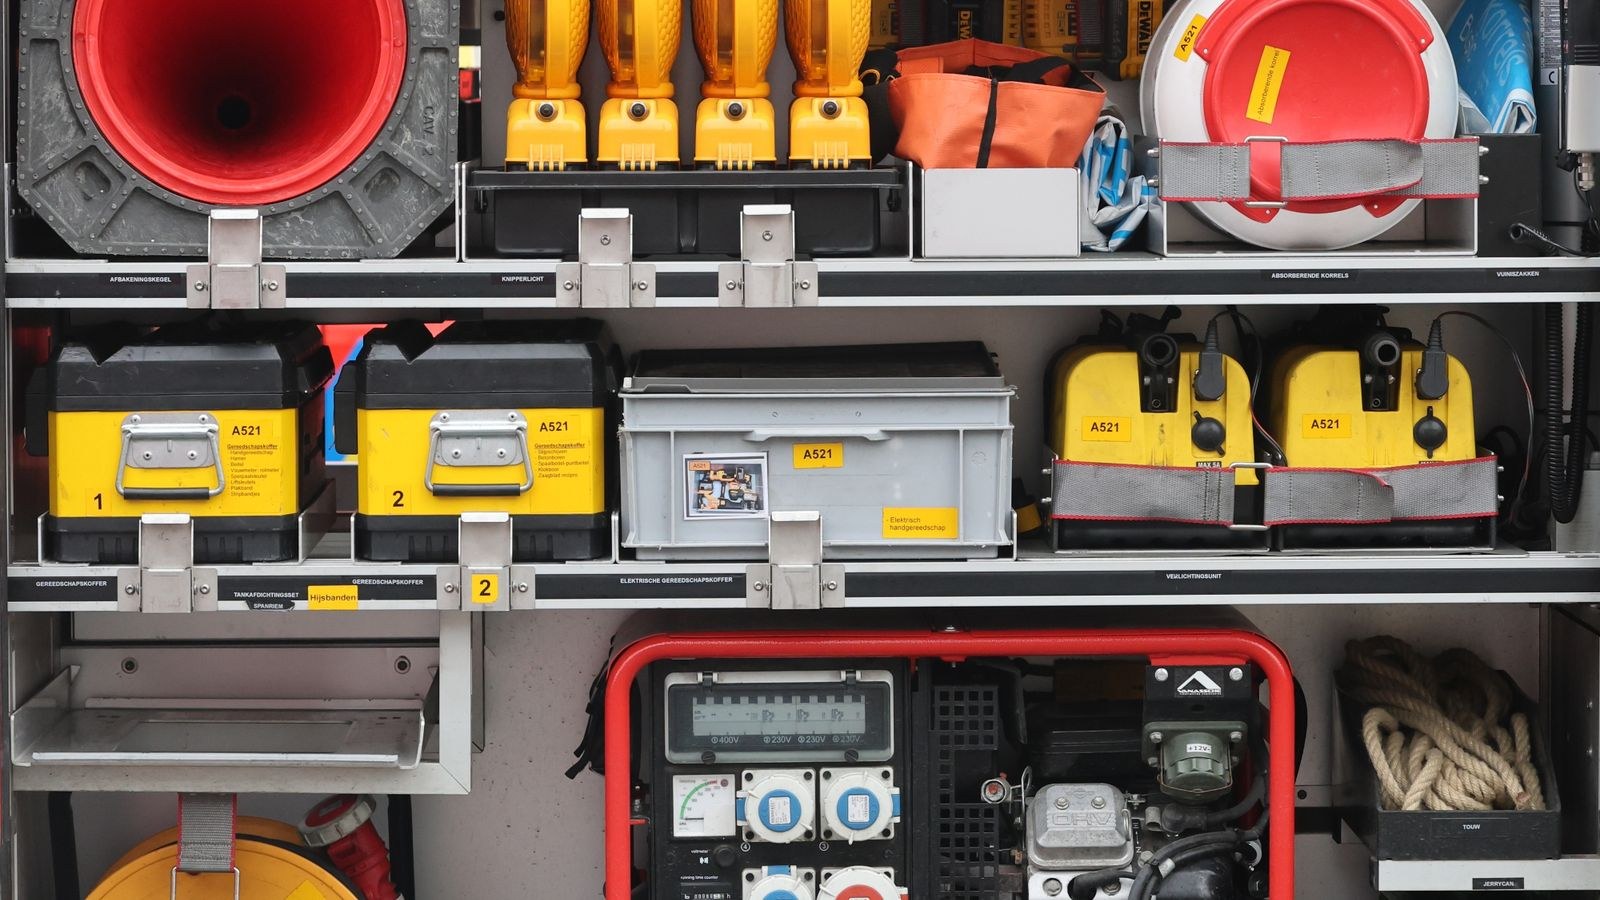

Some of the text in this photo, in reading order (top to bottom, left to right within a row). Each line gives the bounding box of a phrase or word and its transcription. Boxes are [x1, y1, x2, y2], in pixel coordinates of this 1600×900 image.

[1180, 25, 1198, 52] A521
[1257, 70, 1274, 116] Absorberende
[539, 421, 568, 432] A521
[1090, 422, 1120, 433] A521
[1311, 419, 1340, 429] A521
[231, 425, 261, 436] A521
[803, 449, 833, 460] A521
[93, 493, 103, 510] 1
[392, 490, 405, 508] 2
[890, 524, 946, 532] handgereedschap
[352, 578, 424, 586] GEREEDSCHAPSKOFFER
[479, 579, 491, 596] 2
[310, 594, 357, 604] Hijsbanden
[719, 736, 740, 744] 400V
[771, 736, 792, 744] 230V
[805, 736, 826, 744] 230V
